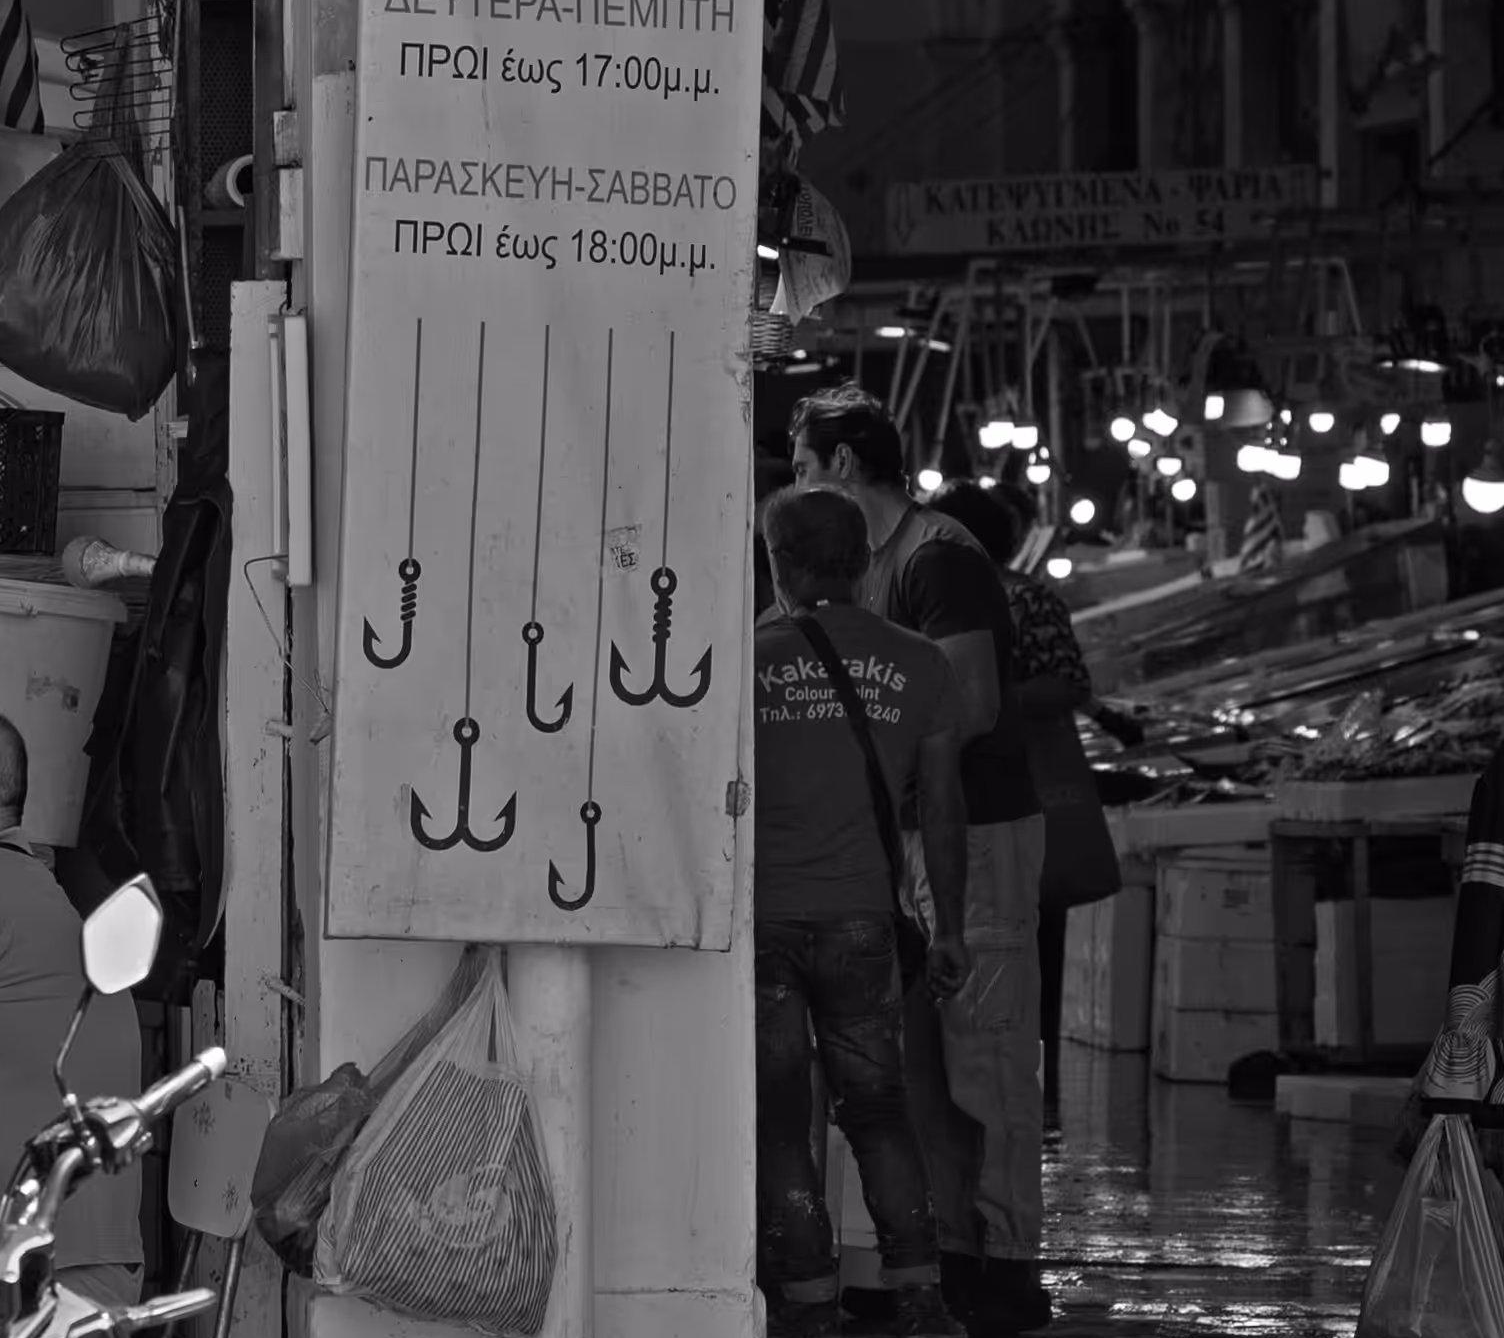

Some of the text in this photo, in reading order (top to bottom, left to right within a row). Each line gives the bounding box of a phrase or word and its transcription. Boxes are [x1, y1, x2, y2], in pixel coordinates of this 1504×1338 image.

[400, 43, 720, 98] ΠΡΩΙ έως 17:00μ.μ.
[364, 156, 737, 210] ΠΑΡΑΣΚΕΥΗ-ΣΑΒΒΑΤΟ
[394, 219, 716, 275] ΠΡΩΙ έως 18:00μ.μ.
[758, 656, 906, 693] Kakaakis
[785, 686, 838, 701] Colour
